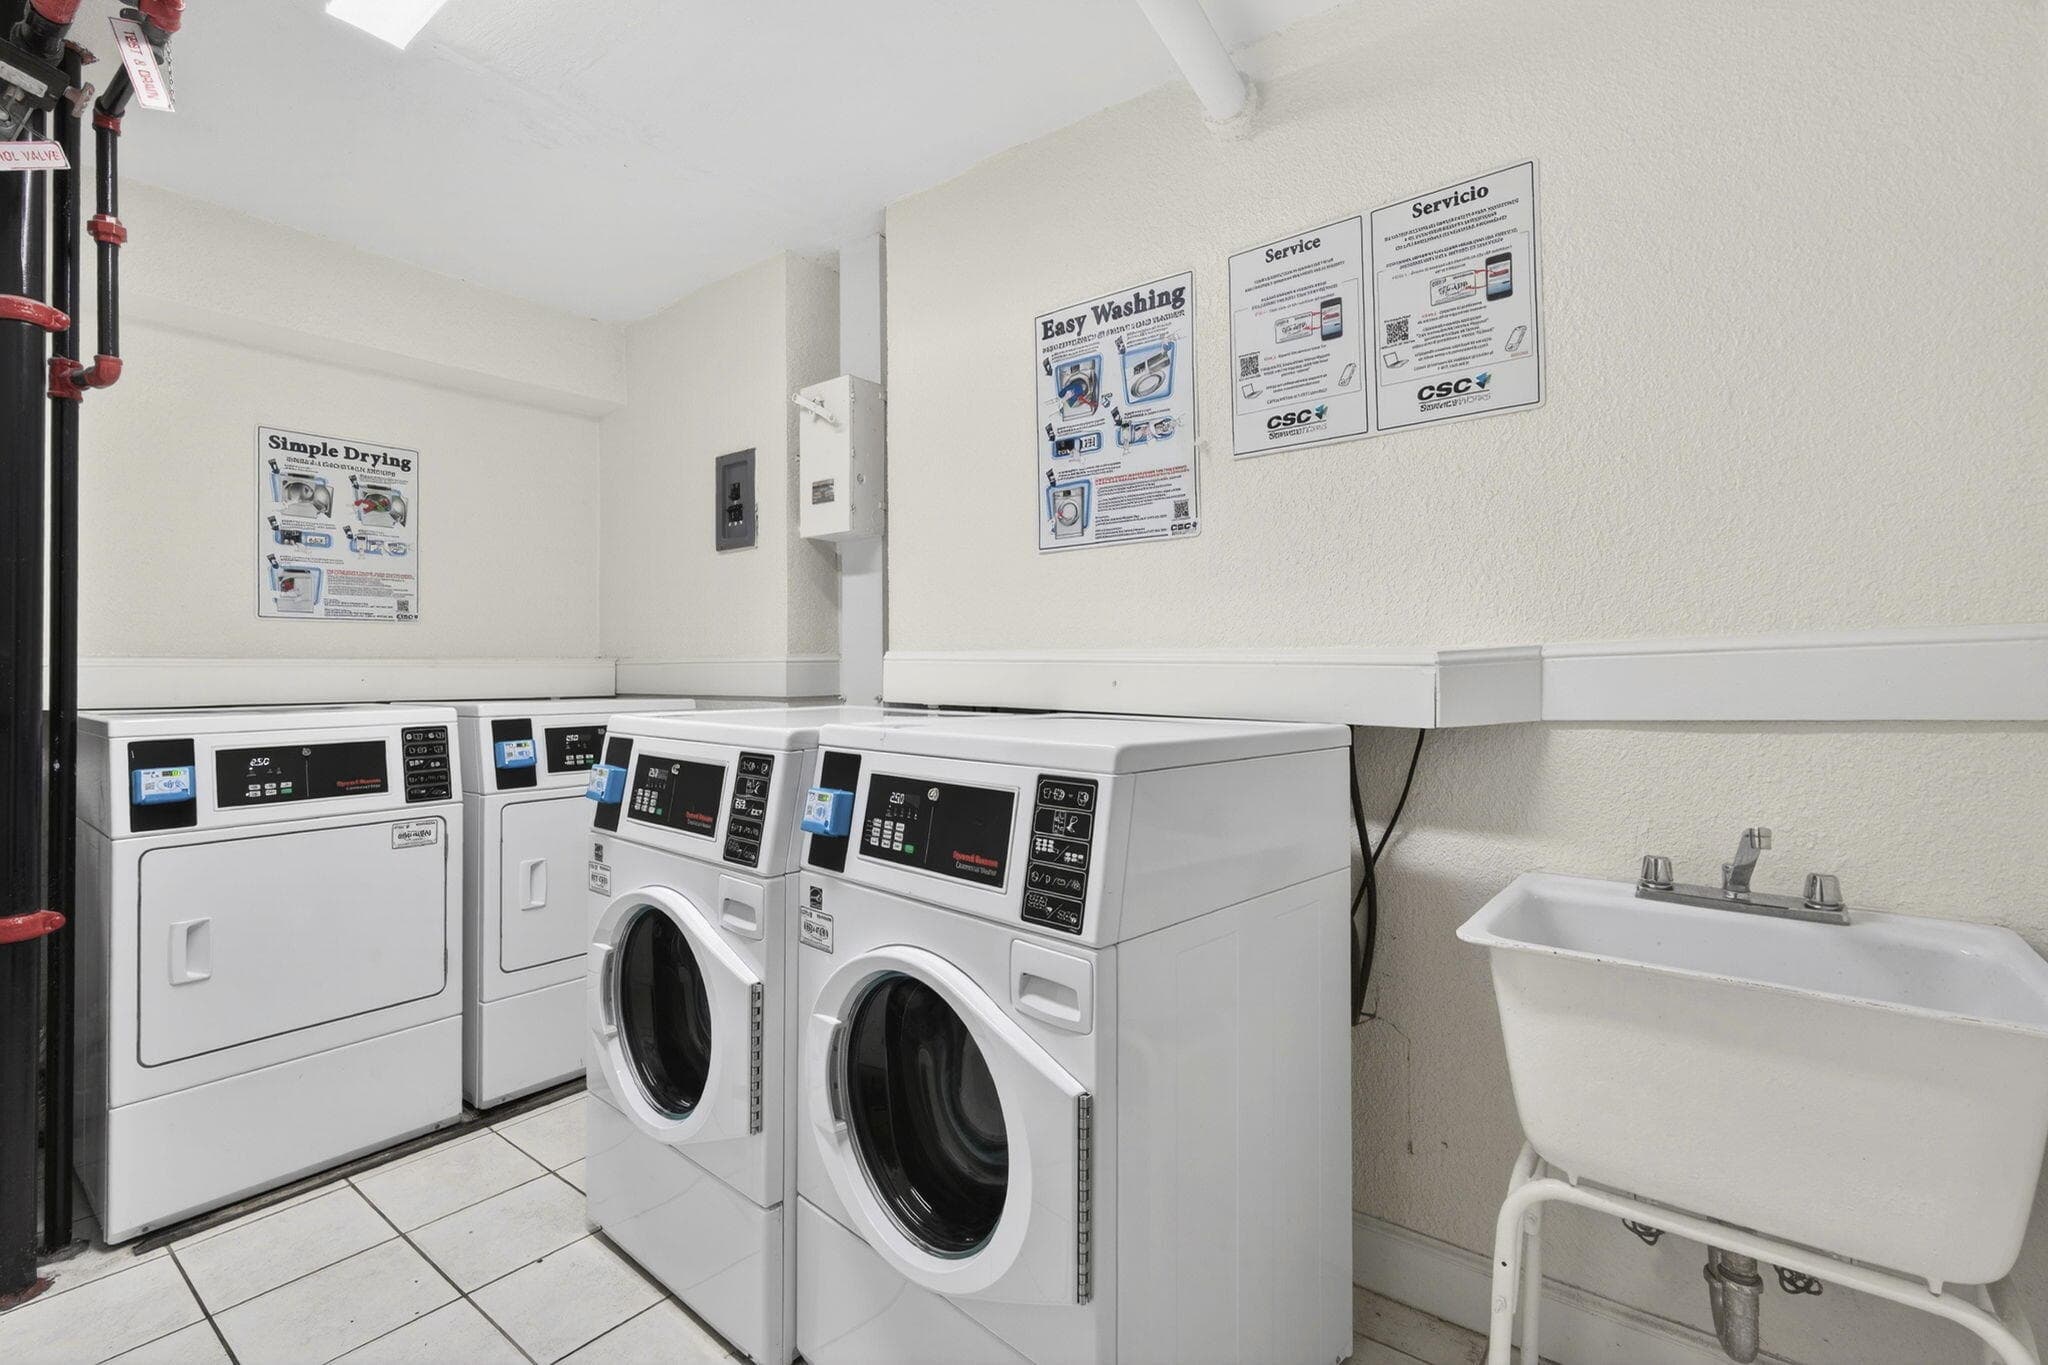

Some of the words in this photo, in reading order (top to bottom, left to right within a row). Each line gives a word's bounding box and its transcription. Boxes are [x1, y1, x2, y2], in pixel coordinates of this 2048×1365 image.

[22, 150, 61, 161] VALVE
[1412, 185, 1489, 219] Servicio
[1265, 237, 1321, 263] Service
[1041, 314, 1087, 340] Easy
[1091, 286, 1186, 326] Washing
[1417, 377, 1473, 401] CSC
[1267, 408, 1312, 429] CSC
[268, 434, 339, 459] Simple
[343, 445, 412, 473] Drying
